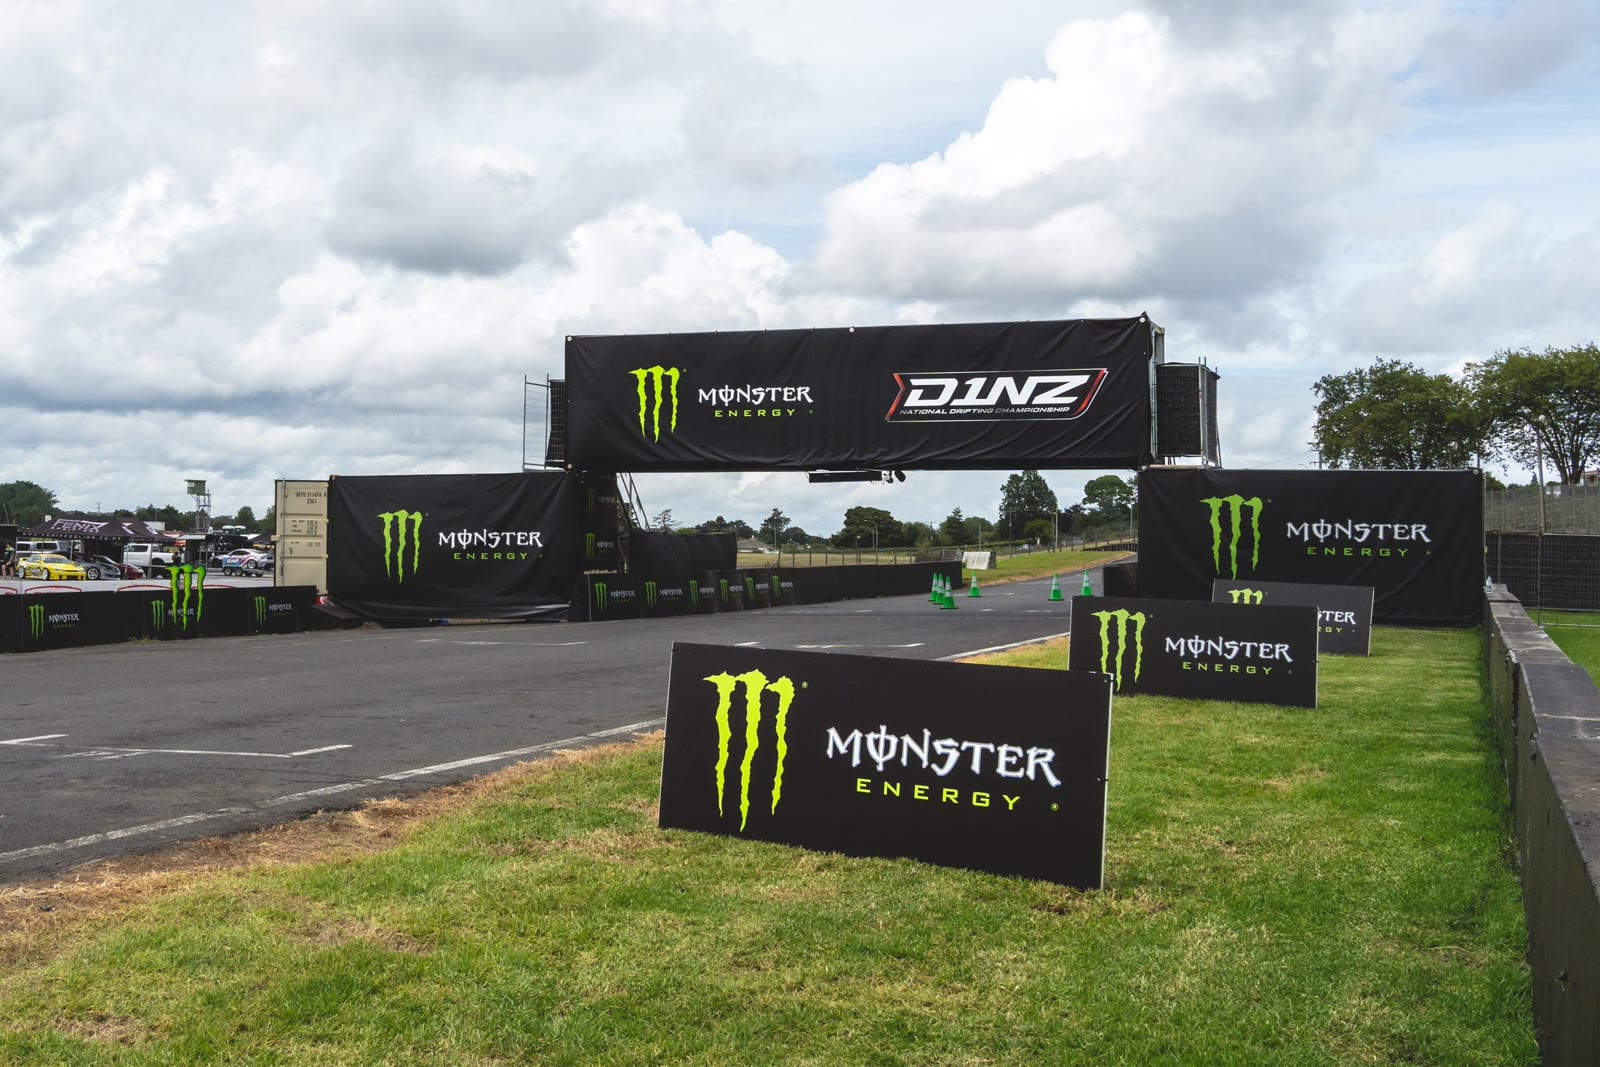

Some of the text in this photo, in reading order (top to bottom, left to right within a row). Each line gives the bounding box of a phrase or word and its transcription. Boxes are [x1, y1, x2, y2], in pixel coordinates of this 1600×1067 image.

[698, 382, 813, 407] MONSTER
[904, 375, 1090, 406] D1NZ
[714, 409, 796, 419] ENERGY
[438, 528, 543, 550] MONSTER
[1286, 519, 1432, 543] MONSTER
[1307, 547, 1408, 557] ENERGY
[48, 613, 79, 623] MONSTER
[1165, 634, 1293, 664] MONSTER
[1182, 661, 1273, 676] ENERGY
[826, 724, 1062, 788] MONSTER
[856, 777, 1021, 811] ENERGY
